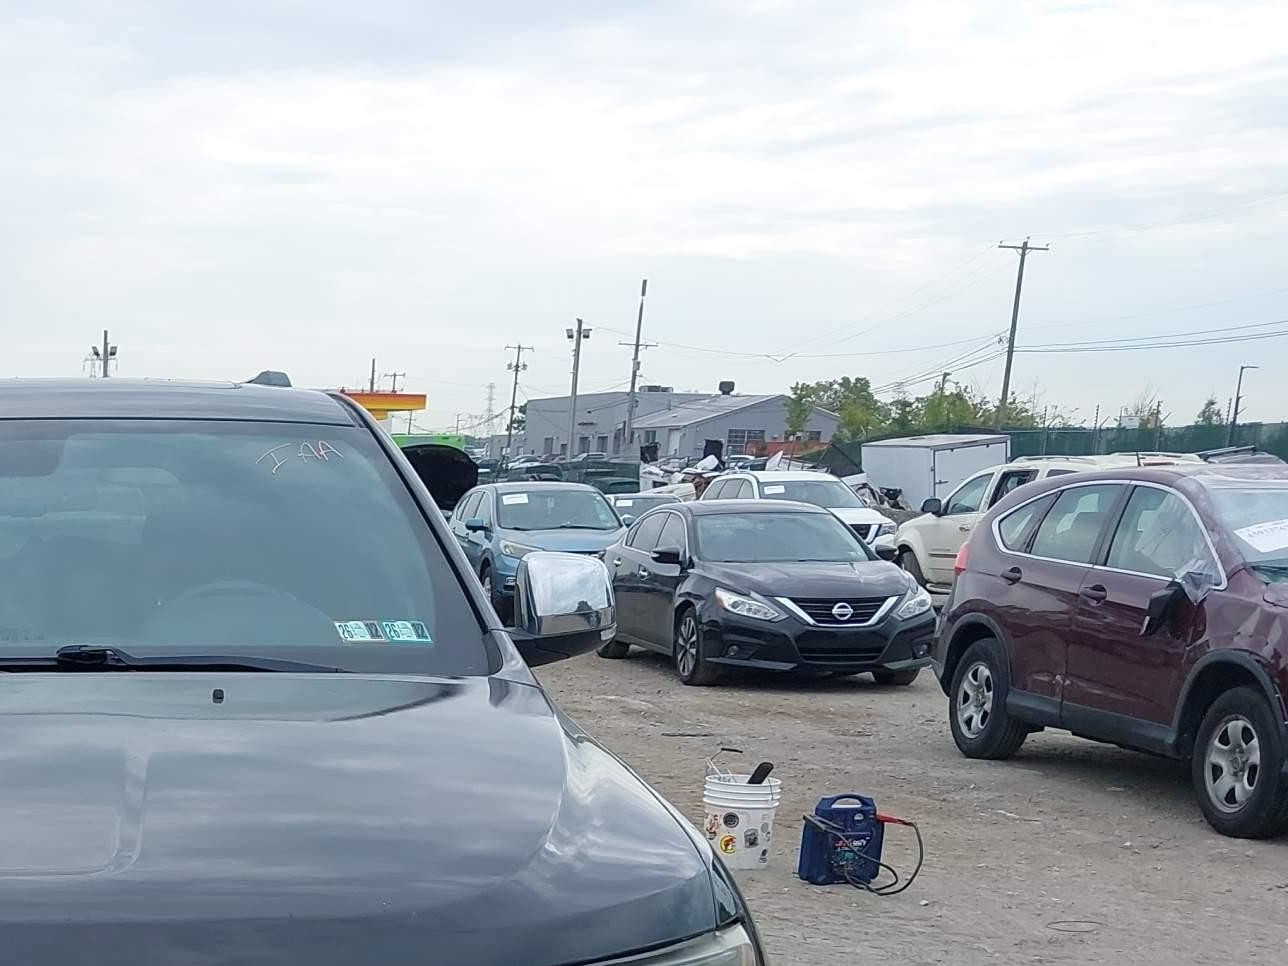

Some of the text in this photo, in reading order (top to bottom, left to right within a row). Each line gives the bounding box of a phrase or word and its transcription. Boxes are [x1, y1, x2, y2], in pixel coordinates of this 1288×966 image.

[255, 440, 344, 474] IAA
[338, 623, 354, 639] 26
[384, 623, 401, 639] 26
